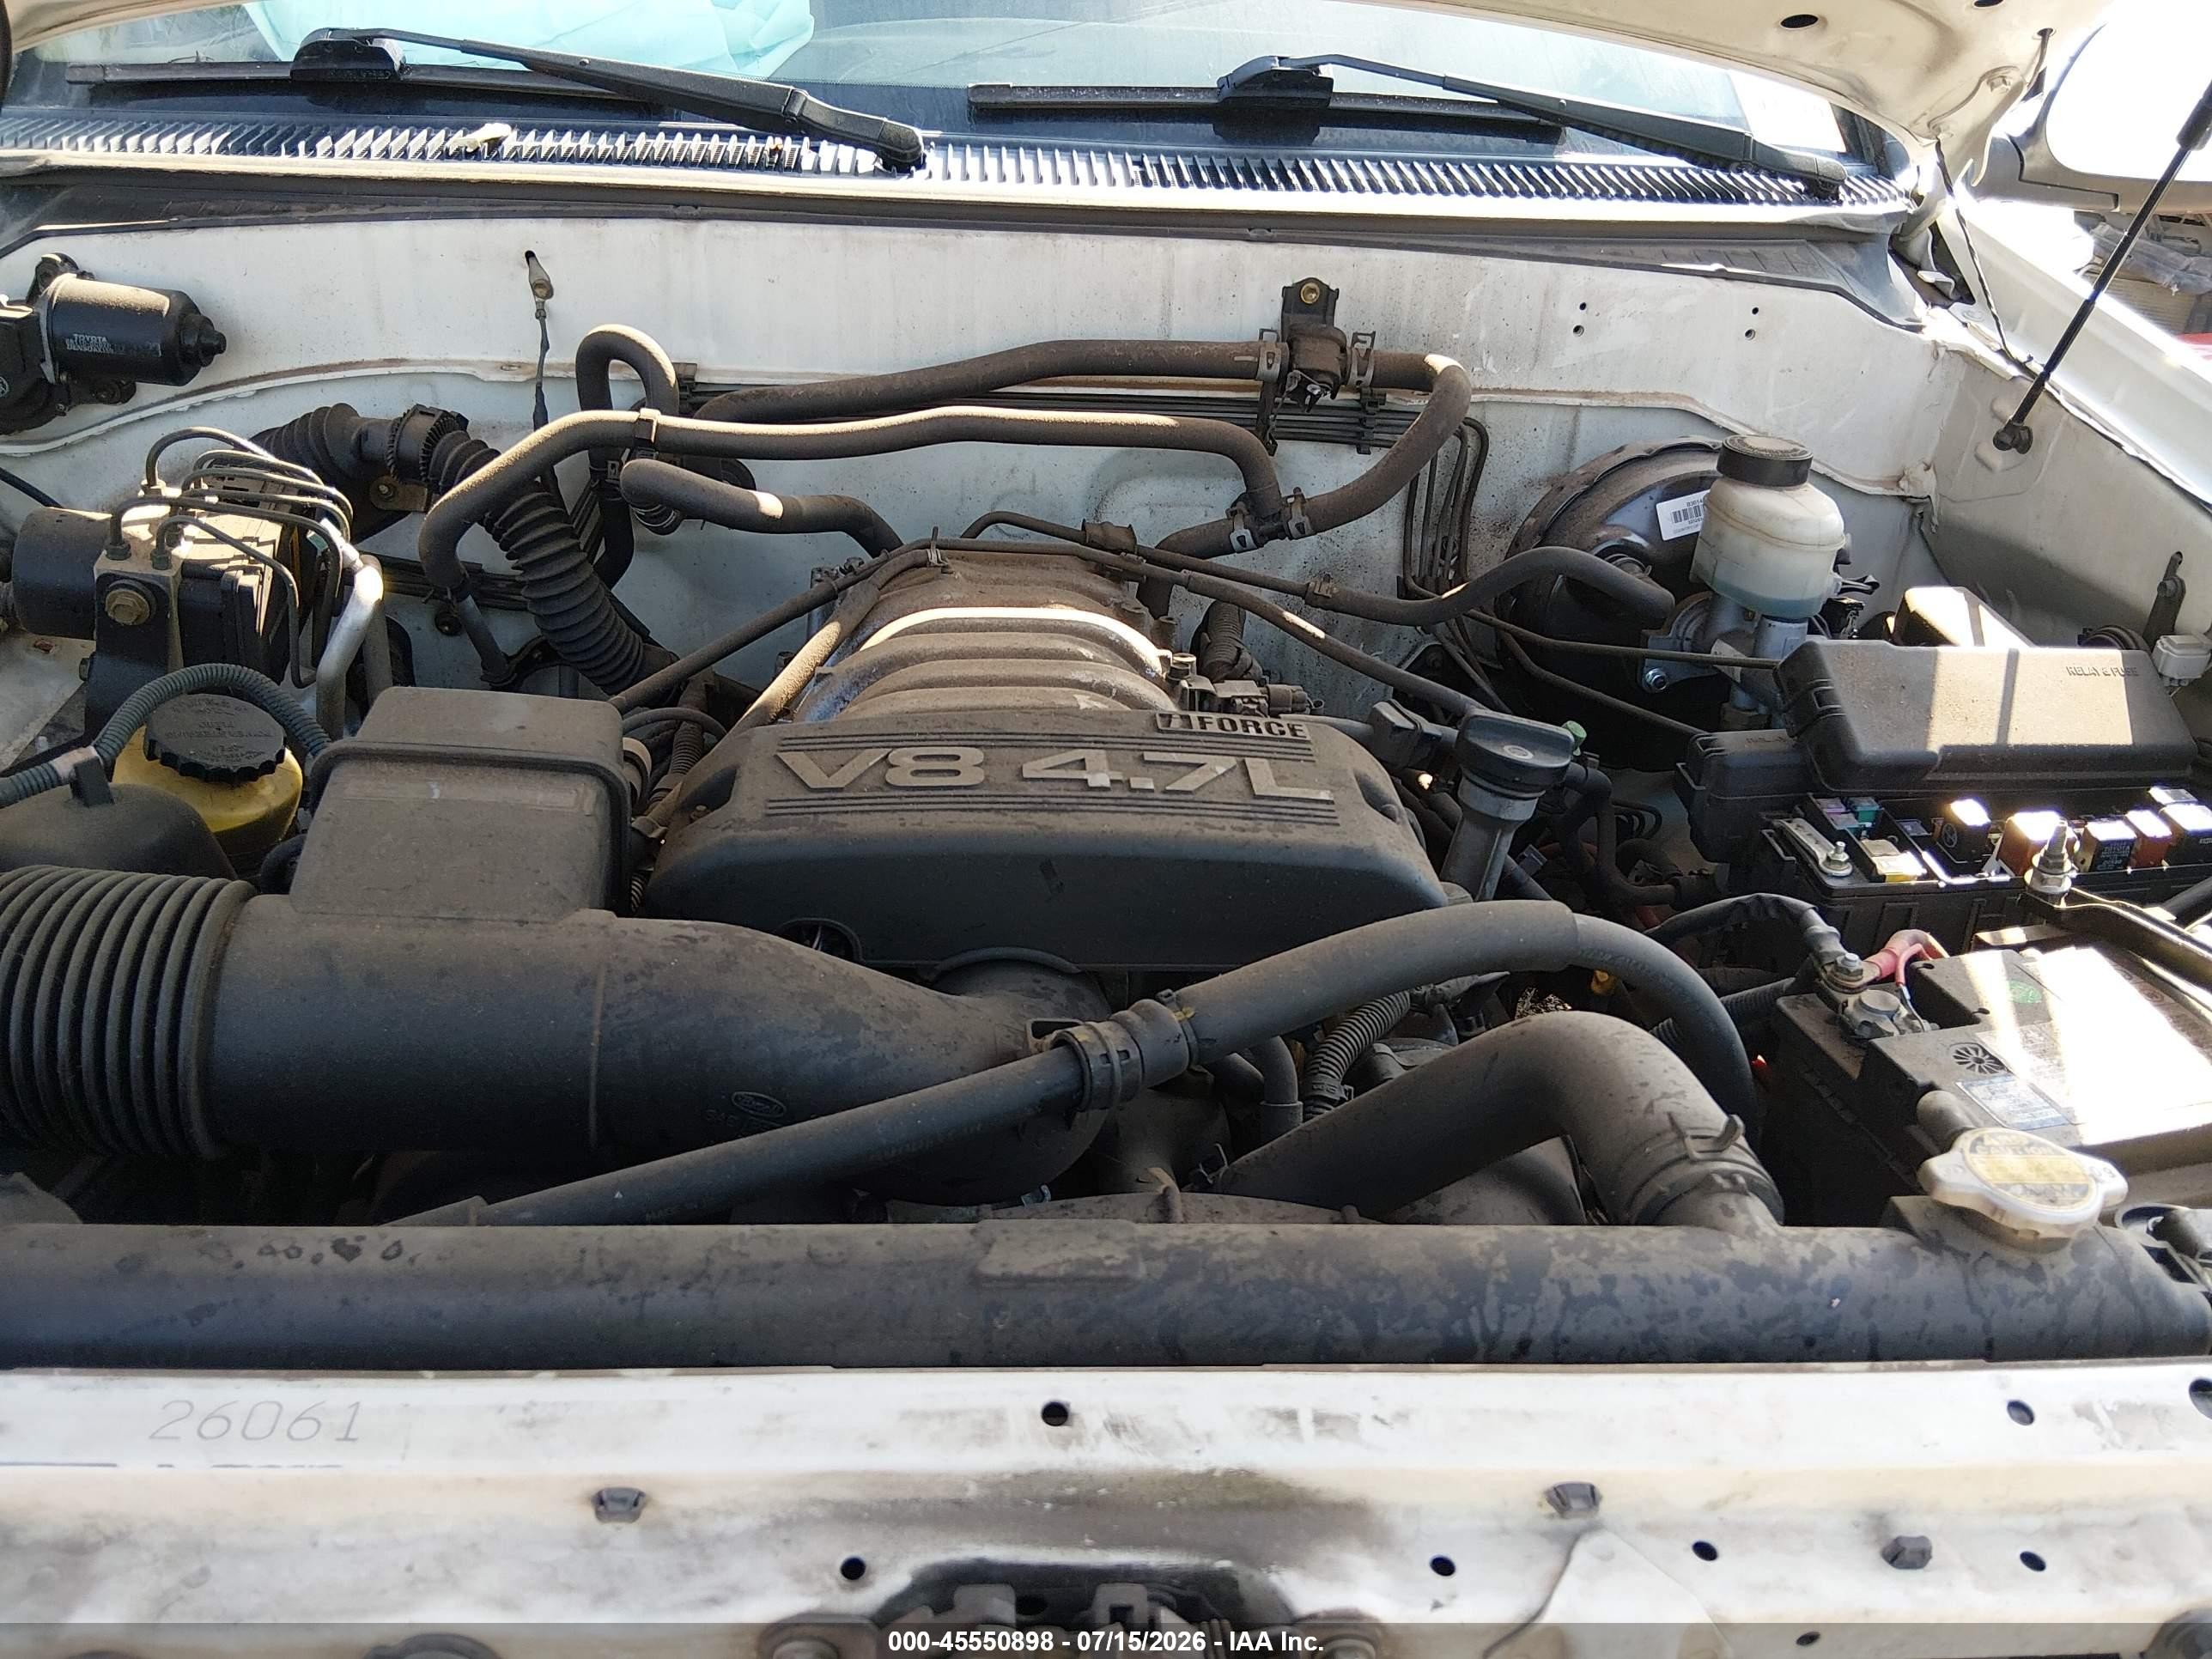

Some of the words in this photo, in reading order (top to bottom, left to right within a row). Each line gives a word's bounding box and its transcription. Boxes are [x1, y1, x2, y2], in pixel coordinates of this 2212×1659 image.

[775, 746, 985, 790] V8
[1022, 749, 1335, 802] 4.7L
[149, 1399, 361, 1442] 26061
